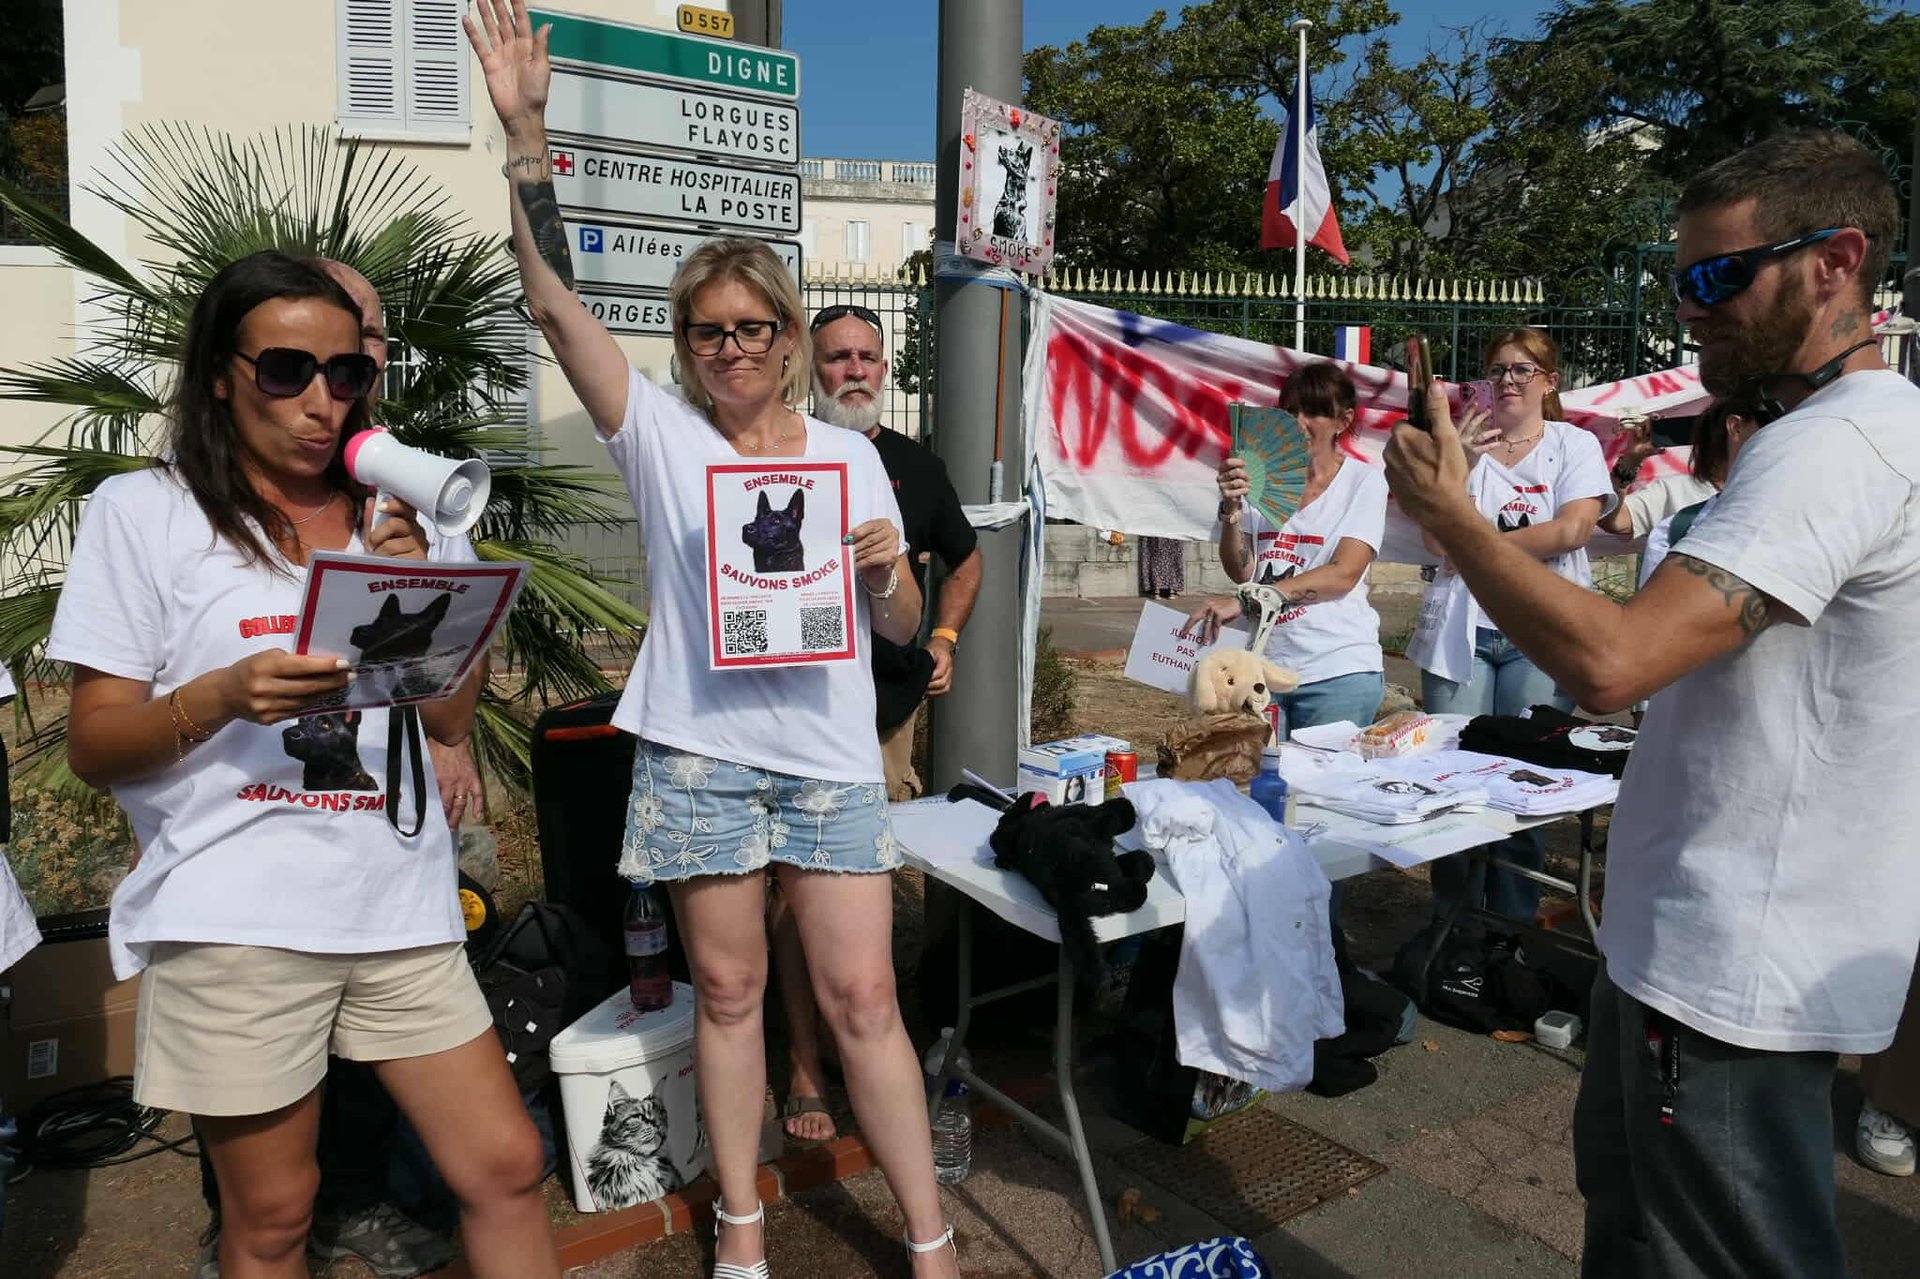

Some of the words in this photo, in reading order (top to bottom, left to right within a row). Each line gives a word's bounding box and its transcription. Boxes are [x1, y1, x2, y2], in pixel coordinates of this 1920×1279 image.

[683, 13, 693, 26] D
[700, 13, 731, 32] 557
[708, 52, 789, 87] DIGNE
[681, 99, 790, 131] LORGUES
[688, 124, 790, 154] FLAYOSC
[584, 157, 662, 184] CENTRE
[670, 168, 793, 200] HOSPITALIER
[681, 194, 707, 214] LA
[721, 199, 792, 223] POSTE
[613, 235, 683, 257] Allées
[990, 236, 1032, 263] SMOKE
[581, 301, 667, 324] ORGES
[743, 474, 815, 492] ENSEMBLE
[1259, 549, 1306, 568] ENSEMBLE
[367, 578, 470, 594] ENSEMBLE
[720, 563, 788, 590] SAUVONS
[792, 559, 840, 588] SMOKE
[1152, 652, 1192, 672] EUTHAN
[1176, 645, 1196, 658] PAS
[237, 783, 351, 811] SAUVONS
